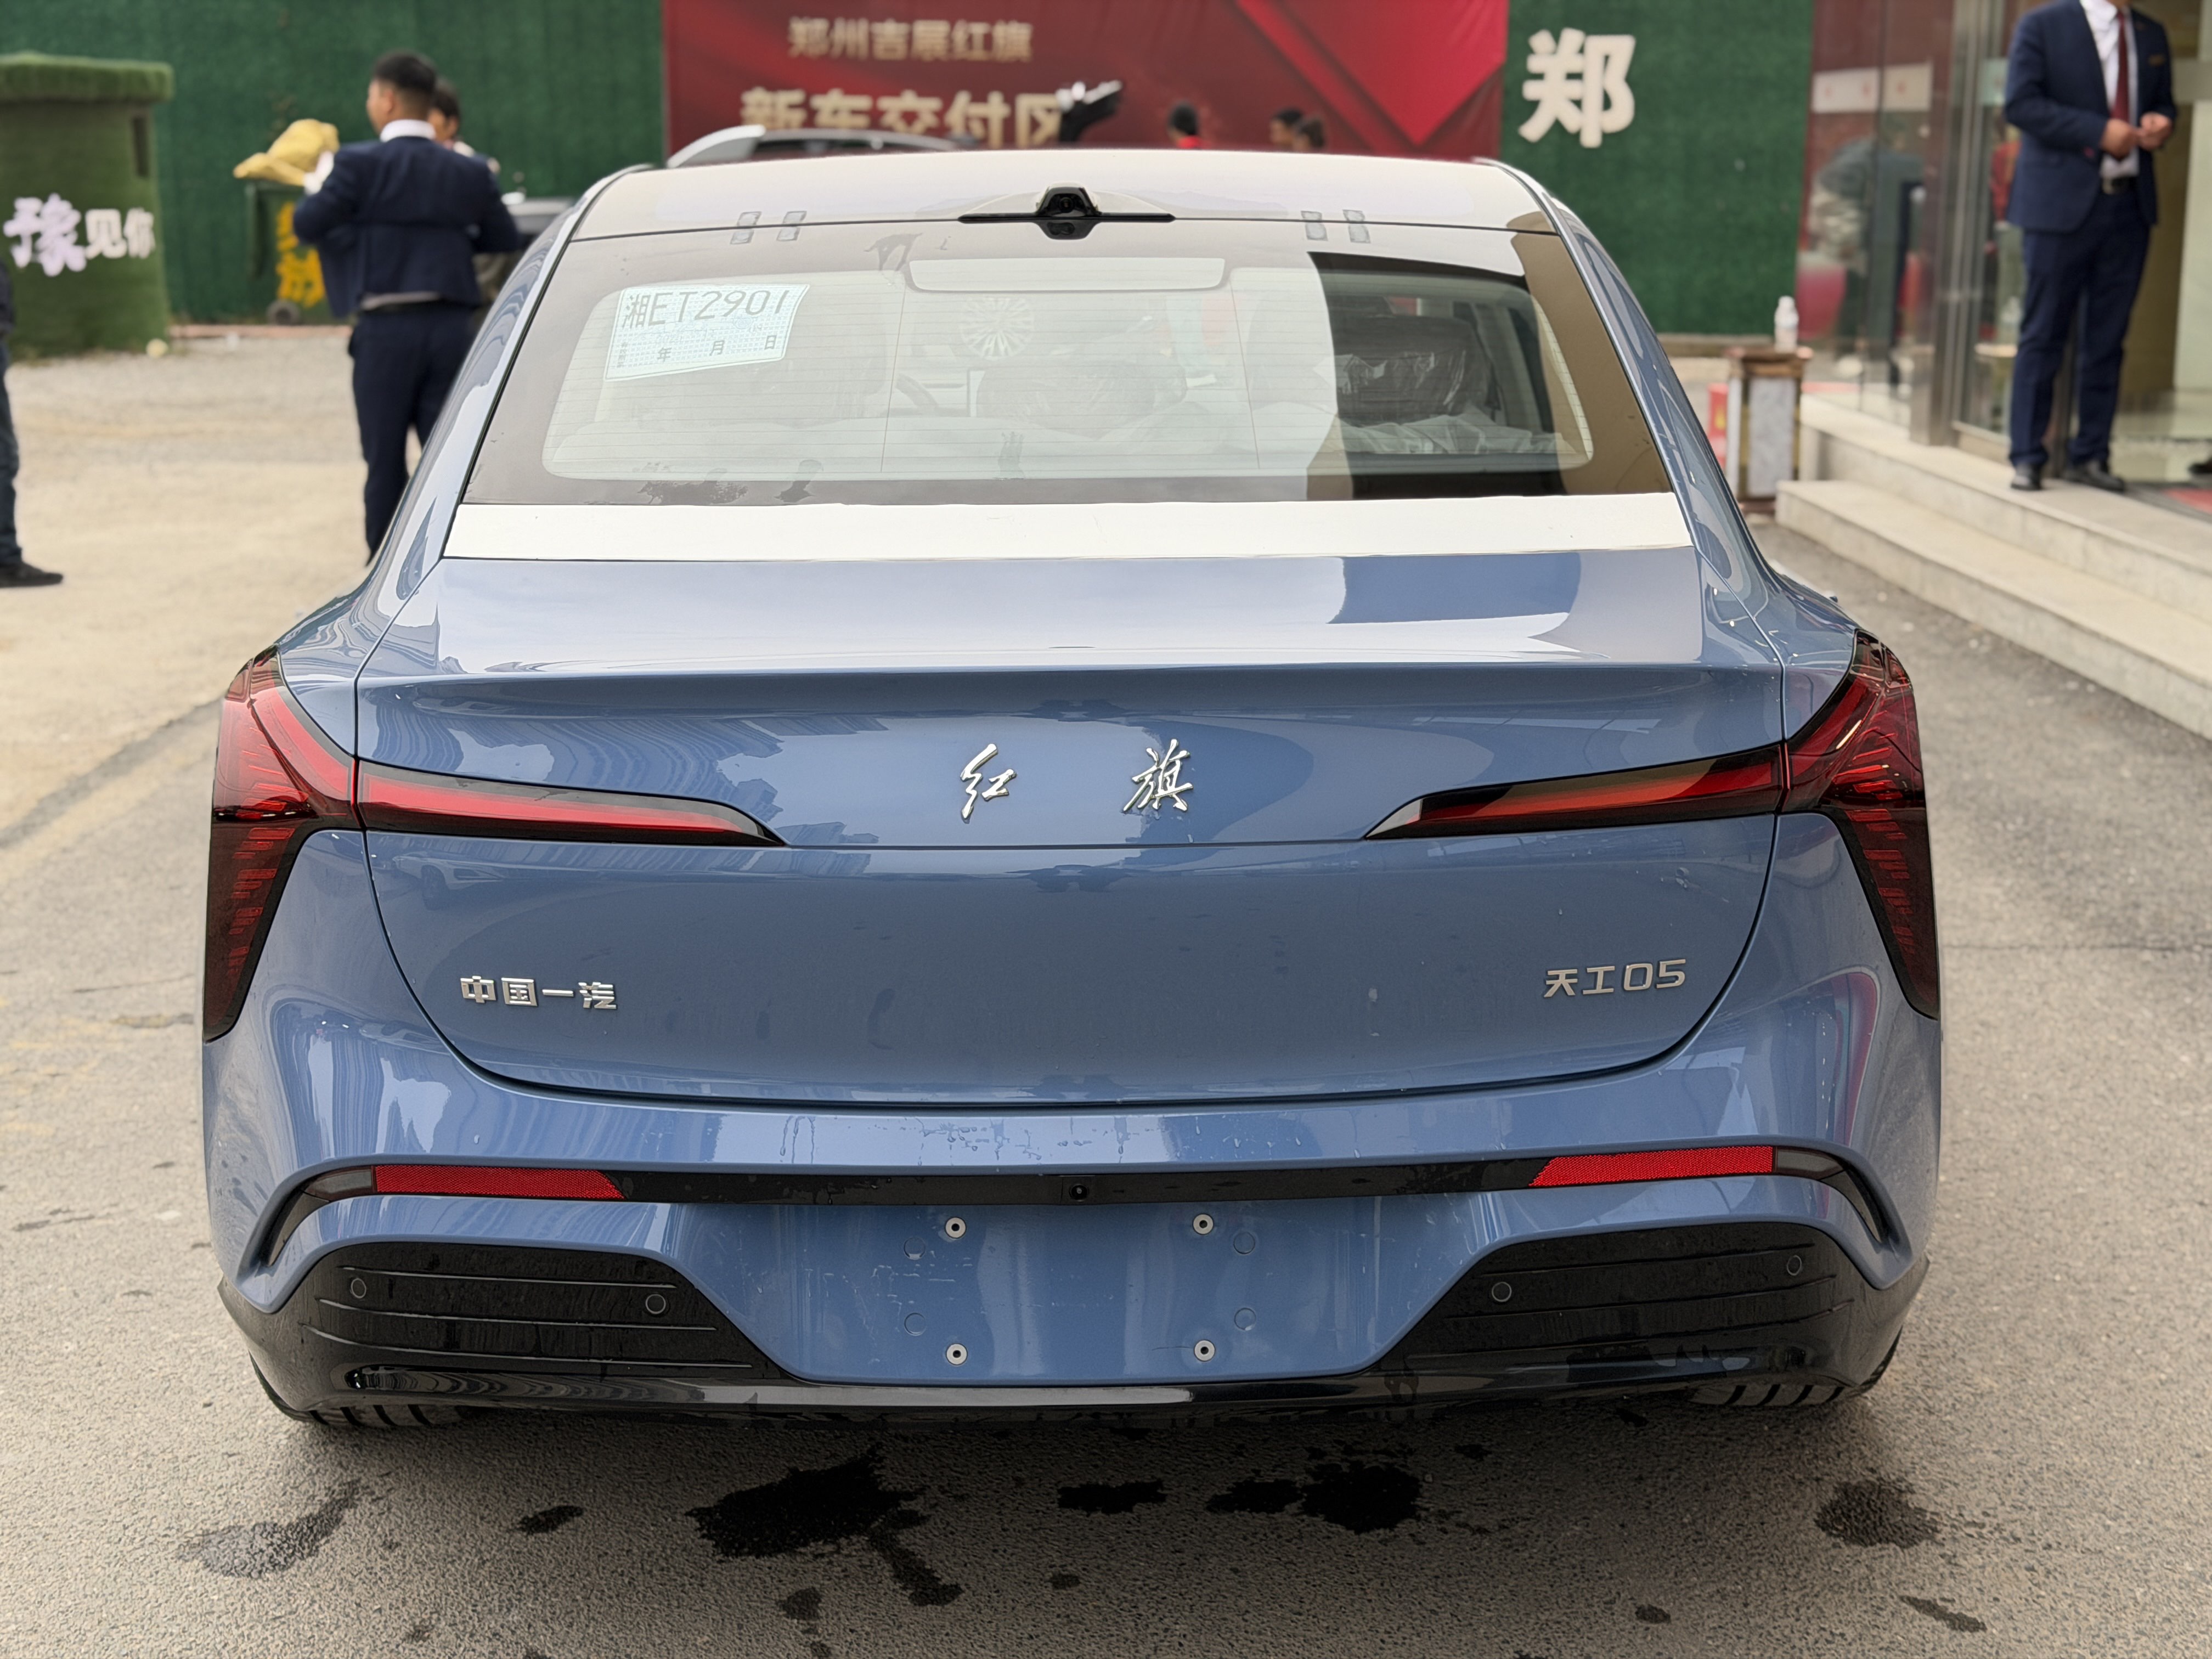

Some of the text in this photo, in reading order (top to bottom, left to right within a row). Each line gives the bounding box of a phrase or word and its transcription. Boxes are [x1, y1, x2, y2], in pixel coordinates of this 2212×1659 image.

[1518, 27, 1635, 148] 郑
[740, 87, 1062, 148] 新车交付区
[622, 290, 790, 329] 湘ET2901
[657, 335, 777, 363] 年 月 日
[460, 975, 617, 1009] 中国一汽
[1543, 959, 1686, 998] 天工05
